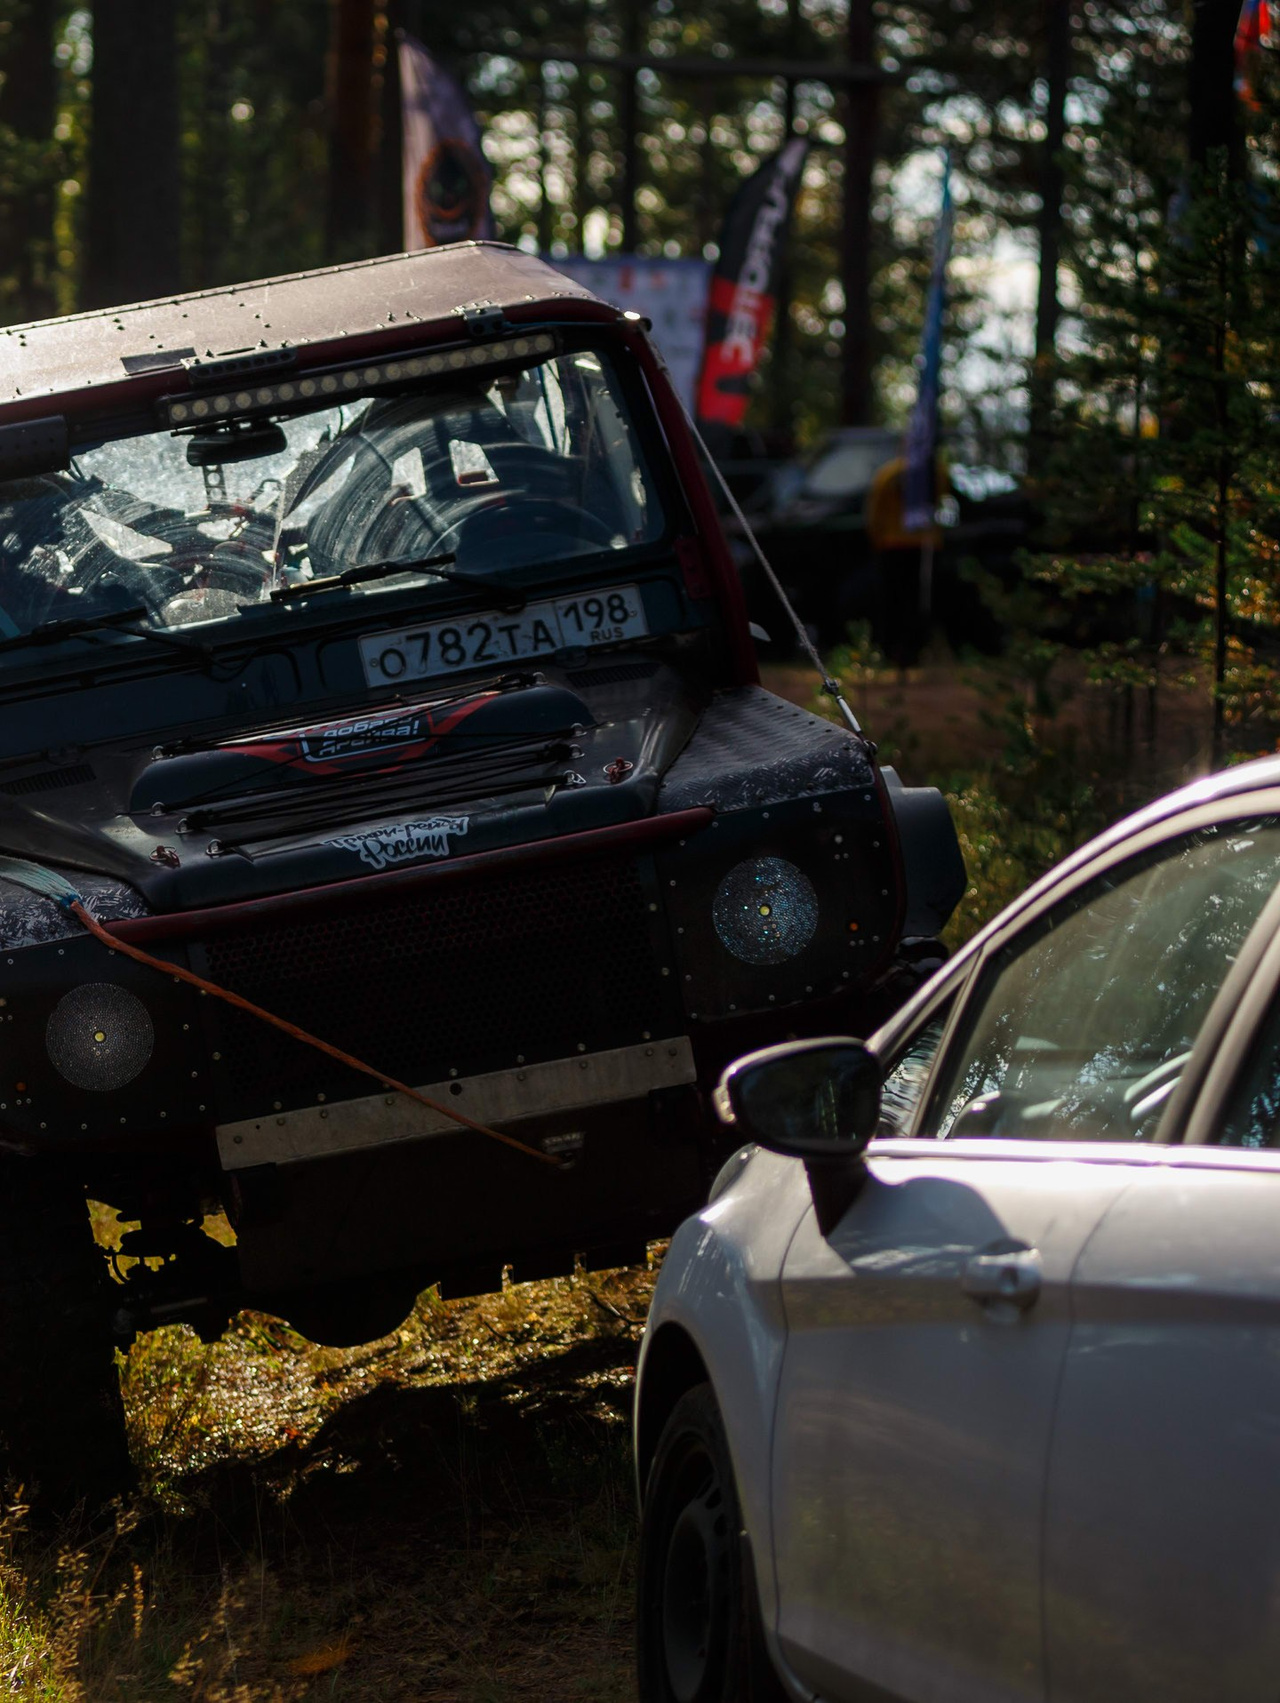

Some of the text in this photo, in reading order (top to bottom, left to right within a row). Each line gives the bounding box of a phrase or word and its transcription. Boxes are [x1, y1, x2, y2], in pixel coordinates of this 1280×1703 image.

[378, 593, 629, 679] О782ТА 198
[590, 626, 625, 643] RUS
[361, 834, 444, 864] России
